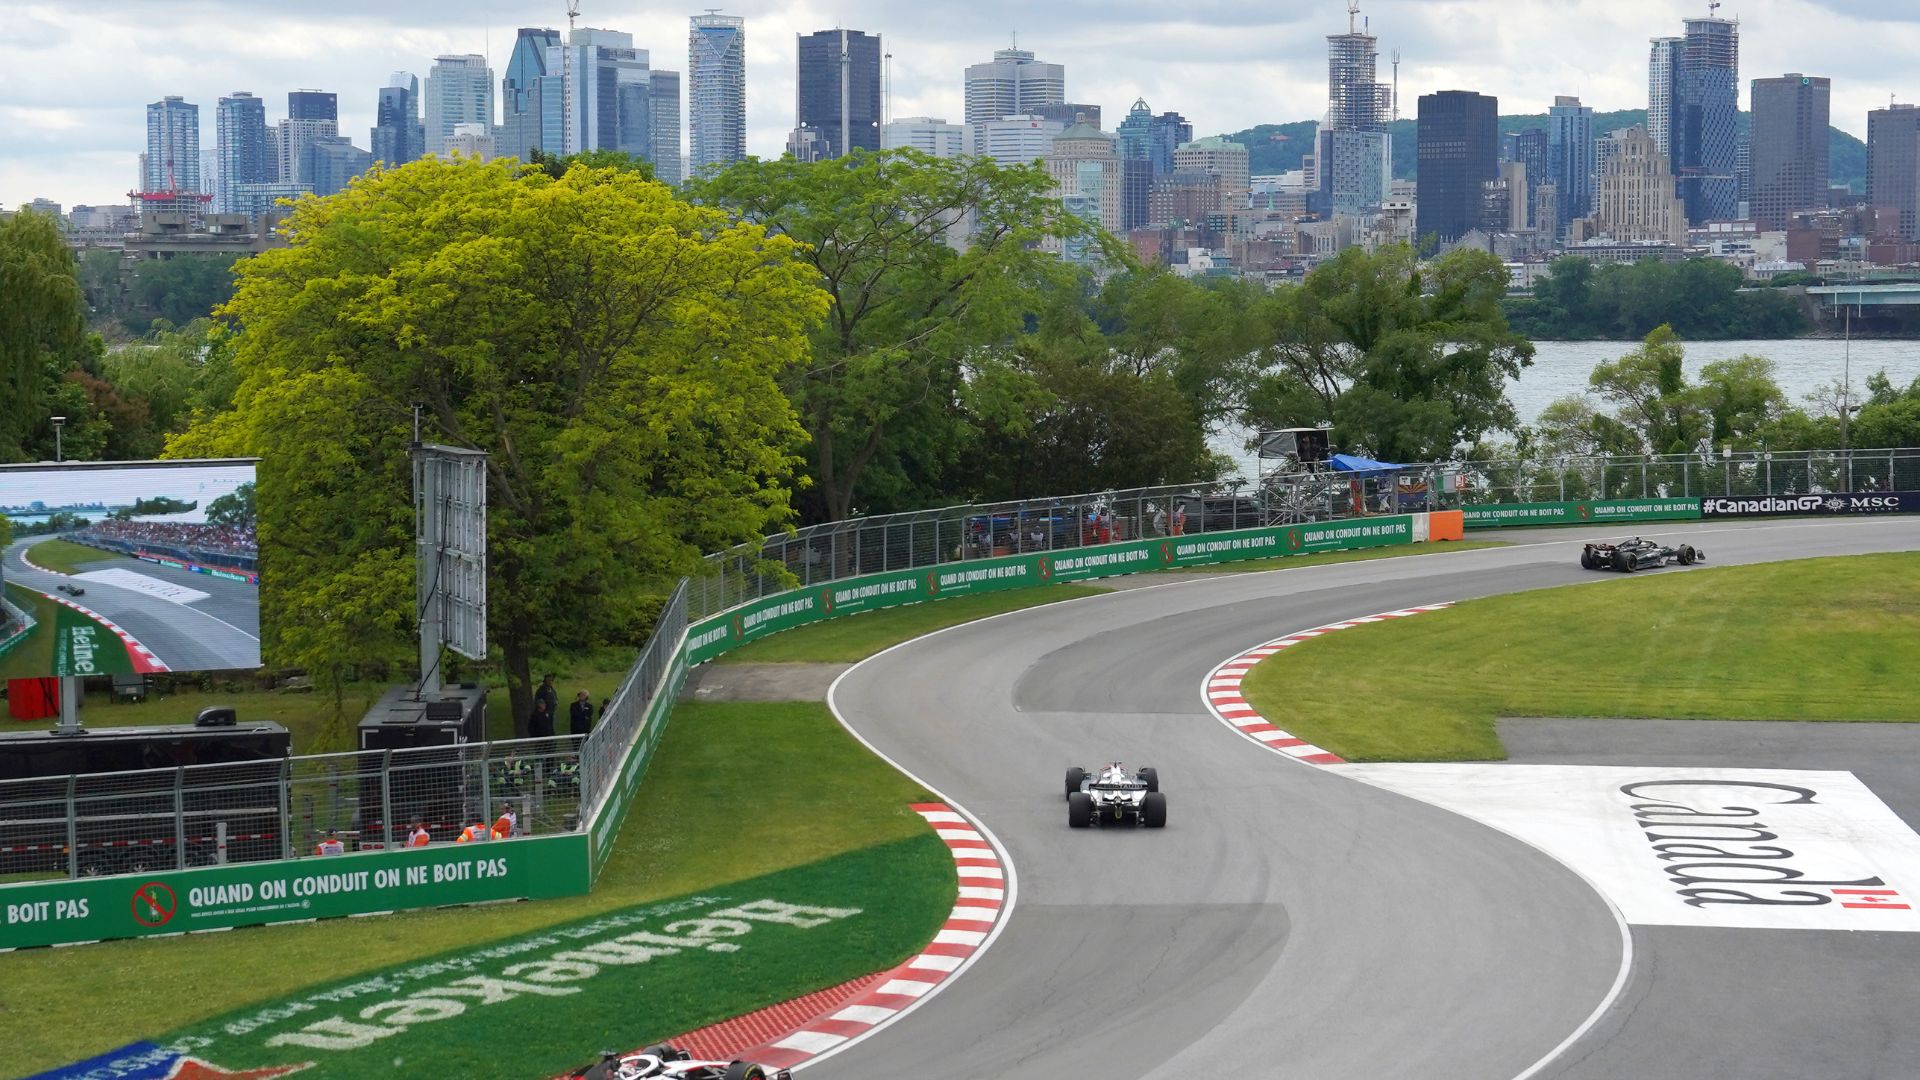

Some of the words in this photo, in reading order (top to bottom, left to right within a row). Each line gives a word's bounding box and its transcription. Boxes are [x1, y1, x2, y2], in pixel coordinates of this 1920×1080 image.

[1594, 506, 1615, 514] QUAND
[1627, 504, 1652, 512] CONDUIT
[1704, 496, 1822, 513] #CanadianGP
[1850, 496, 1899, 508] MSC
[1463, 511, 1481, 519] UAND
[1492, 510, 1518, 518] CONDUIT
[1520, 509, 1529, 517] ON
[1539, 508, 1552, 516] BOIT
[1304, 531, 1324, 542] QUAND
[1325, 530, 1334, 539] ON
[1336, 527, 1361, 539] CONDUIT
[1362, 527, 1371, 536] ON
[1372, 526, 1380, 535] NE
[1381, 525, 1394, 535] BOIT
[1396, 524, 1406, 533] PAS
[1176, 544, 1196, 555] QUAND
[1197, 543, 1206, 553] ON
[1207, 540, 1231, 552] CONDUIT
[1232, 539, 1241, 549] ON
[1242, 538, 1250, 548] NE
[1251, 537, 1264, 547] BOIT
[1265, 536, 1276, 546] PAS
[1054, 559, 1074, 571] QUAND
[1075, 558, 1083, 568] ON
[1085, 554, 1108, 567] CONDUIT
[1109, 553, 1117, 564] ON
[1118, 552, 1125, 563] NE
[1126, 550, 1138, 562] BOIT
[1139, 549, 1149, 559] PAS
[941, 573, 957, 586] QUAND
[958, 572, 965, 583] ON
[966, 569, 988, 582] CONDUIT
[988, 568, 996, 579] ON
[997, 567, 1004, 578] NE
[1005, 566, 1016, 577] BOIT
[1017, 565, 1026, 575] PAS
[835, 589, 851, 603] QUAND
[860, 584, 880, 598] CONDUIT
[896, 580, 907, 592] BOIT
[908, 579, 917, 590] PAS
[1620, 780, 1886, 908] Canada
[189, 883, 254, 908] QUAND
[260, 879, 287, 900] ON
[292, 871, 369, 896] CONDUIT
[374, 868, 400, 888] ON
[406, 866, 428, 885] NE
[433, 861, 471, 883] BOIT
[477, 858, 507, 879] PAS
[7, 902, 50, 924] BOIT
[56, 898, 89, 920] PAS
[265, 899, 862, 1051] Heineken
